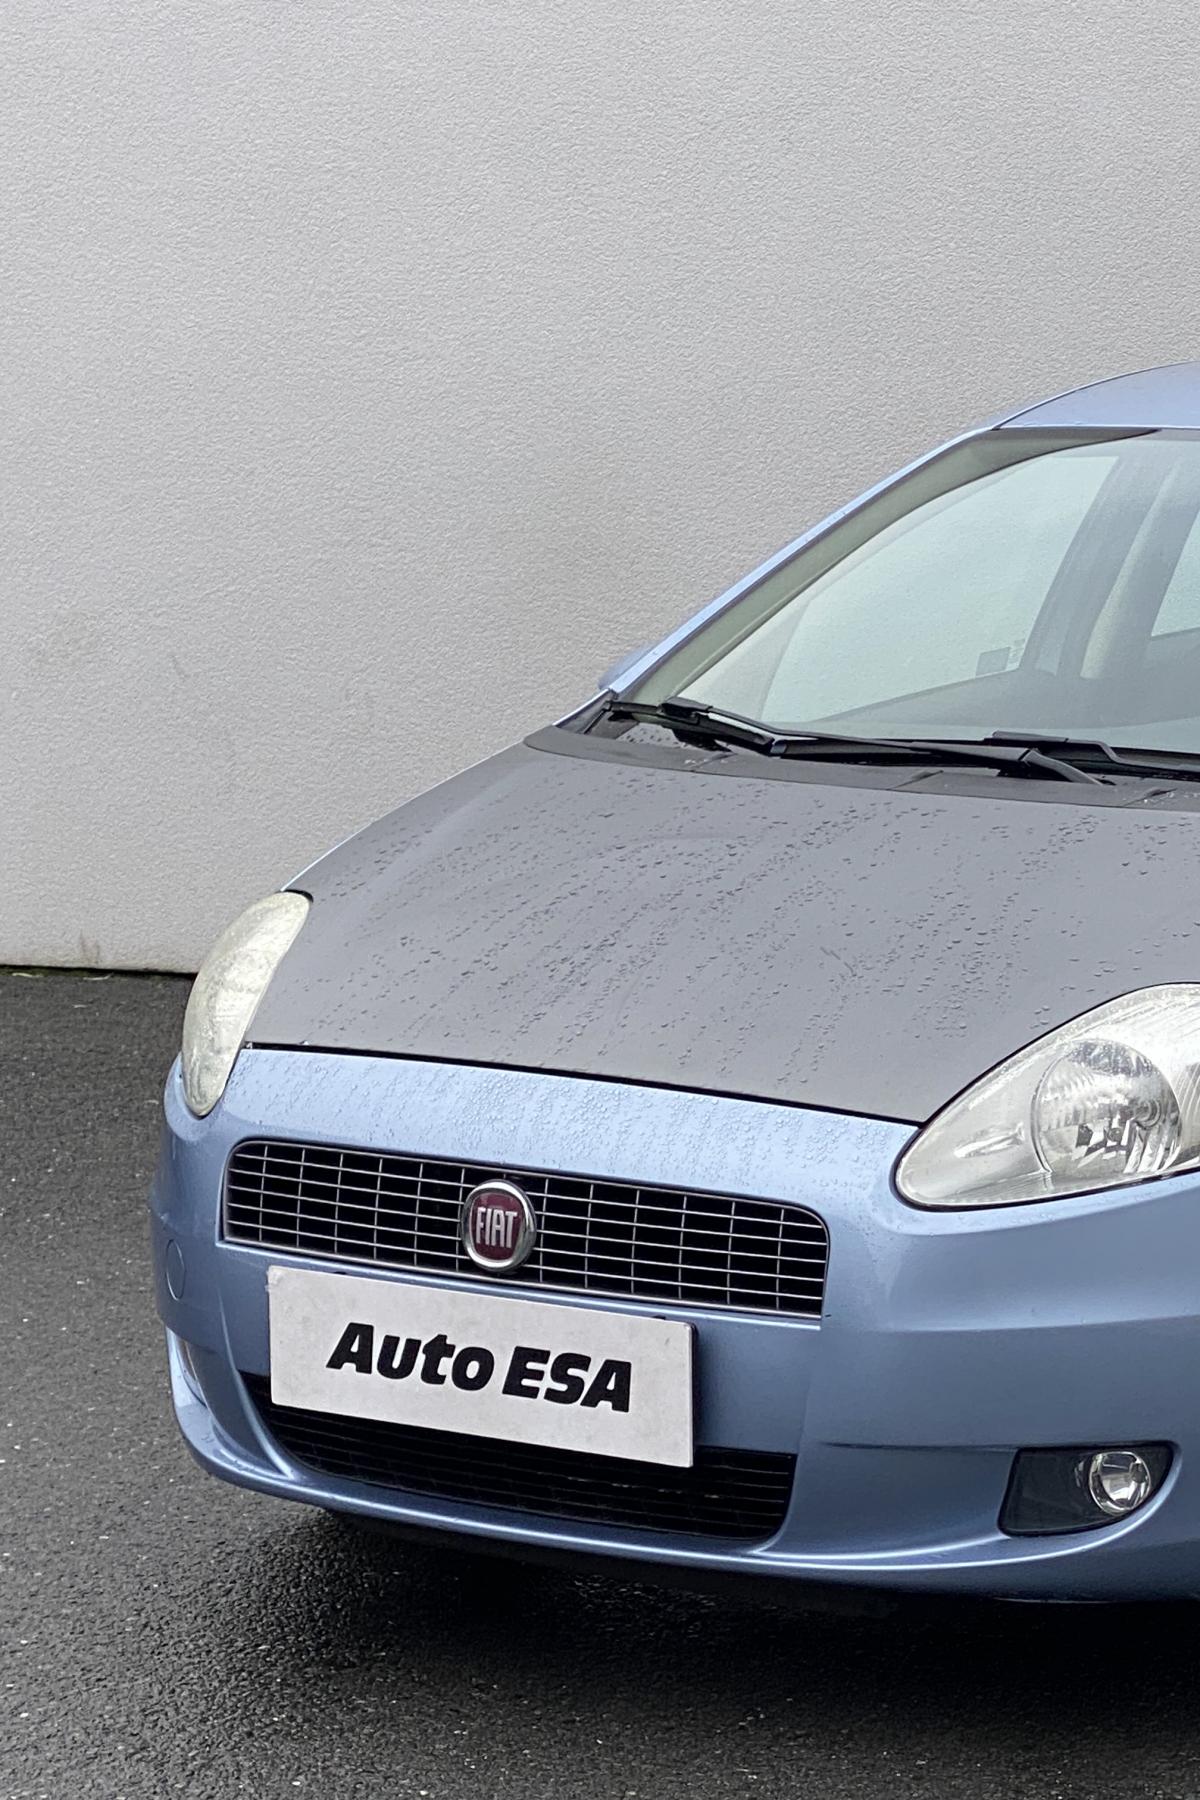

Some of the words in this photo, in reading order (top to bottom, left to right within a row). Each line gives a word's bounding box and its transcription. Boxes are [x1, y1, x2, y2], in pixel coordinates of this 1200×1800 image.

[475, 1207, 518, 1249] FIAT
[326, 1322, 495, 1391] Auto
[502, 1346, 632, 1413] ESA
